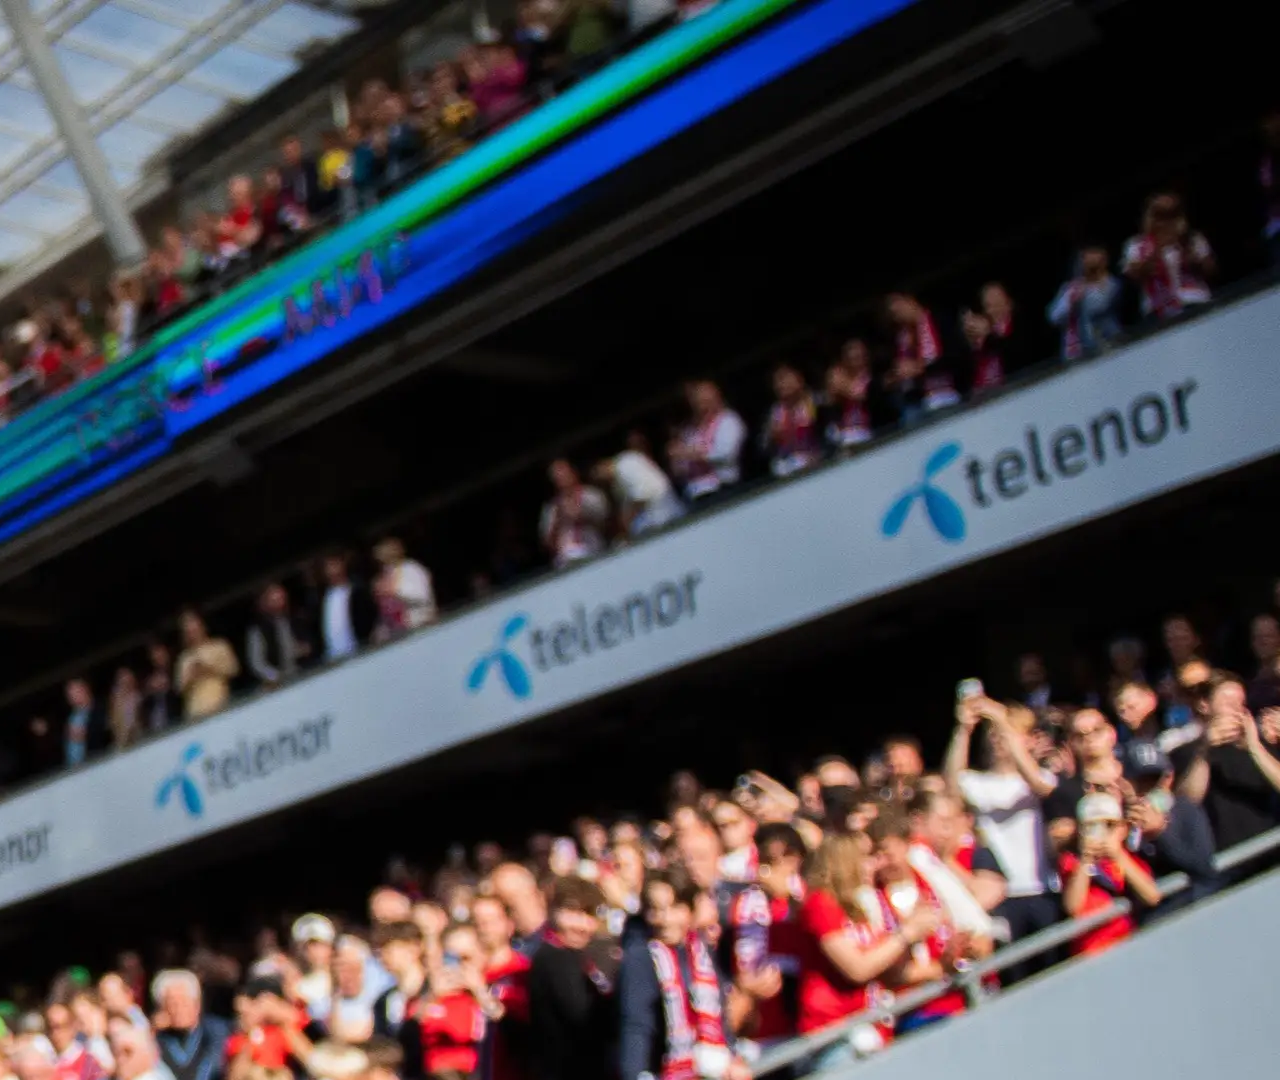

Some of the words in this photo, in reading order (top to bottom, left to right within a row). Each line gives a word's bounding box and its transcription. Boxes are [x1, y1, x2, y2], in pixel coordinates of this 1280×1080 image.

[964, 379, 1200, 508] telenor
[529, 570, 703, 673] telenor
[201, 711, 336, 797] telenor
